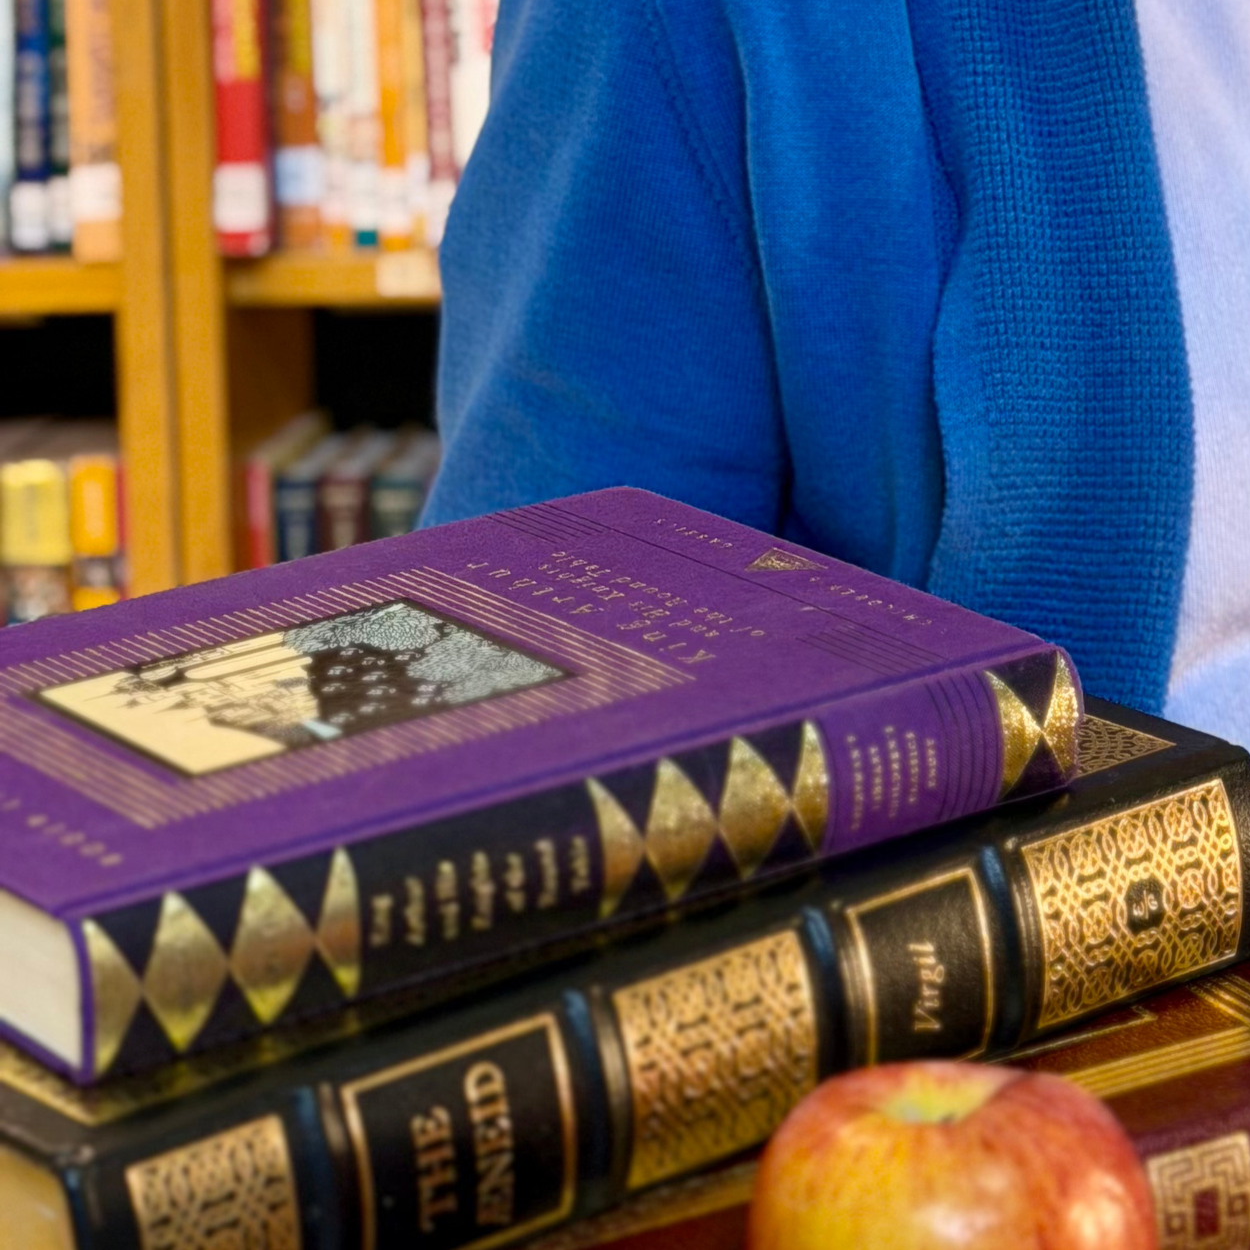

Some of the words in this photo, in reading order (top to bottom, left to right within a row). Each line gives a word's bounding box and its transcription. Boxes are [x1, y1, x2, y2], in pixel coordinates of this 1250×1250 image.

[465, 561, 606, 616] Arthur
[616, 618, 717, 665] King
[908, 937, 945, 1032] Virgil
[410, 1105, 458, 1234] THE
